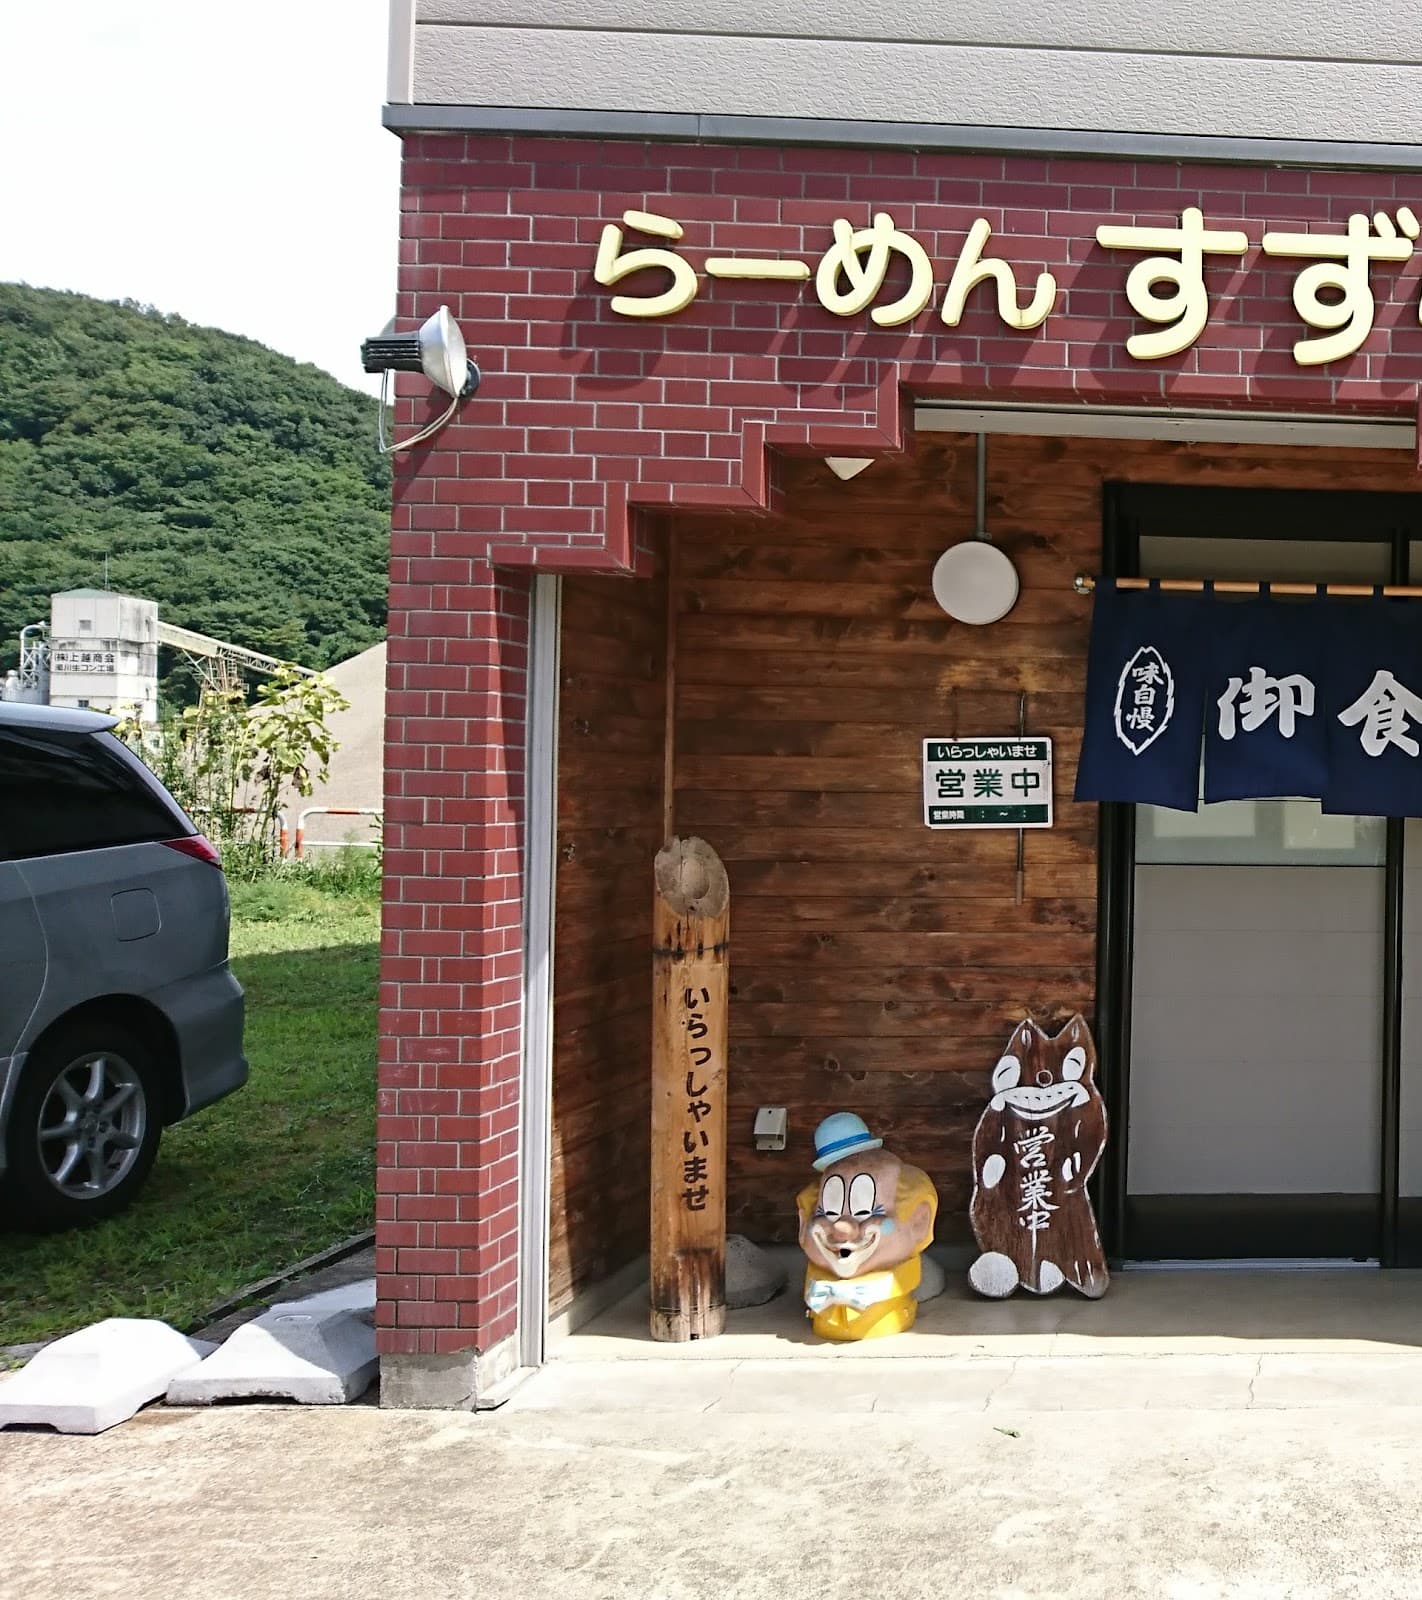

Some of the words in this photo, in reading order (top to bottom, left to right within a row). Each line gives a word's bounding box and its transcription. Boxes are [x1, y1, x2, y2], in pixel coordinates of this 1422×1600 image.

[594, 211, 1055, 328] らーめん
[1126, 662, 1164, 732] 味自慢
[935, 768, 1040, 798] 営業中
[937, 745, 1037, 759] いらっしゃいませ
[1013, 1125, 1060, 1259] 営業中
